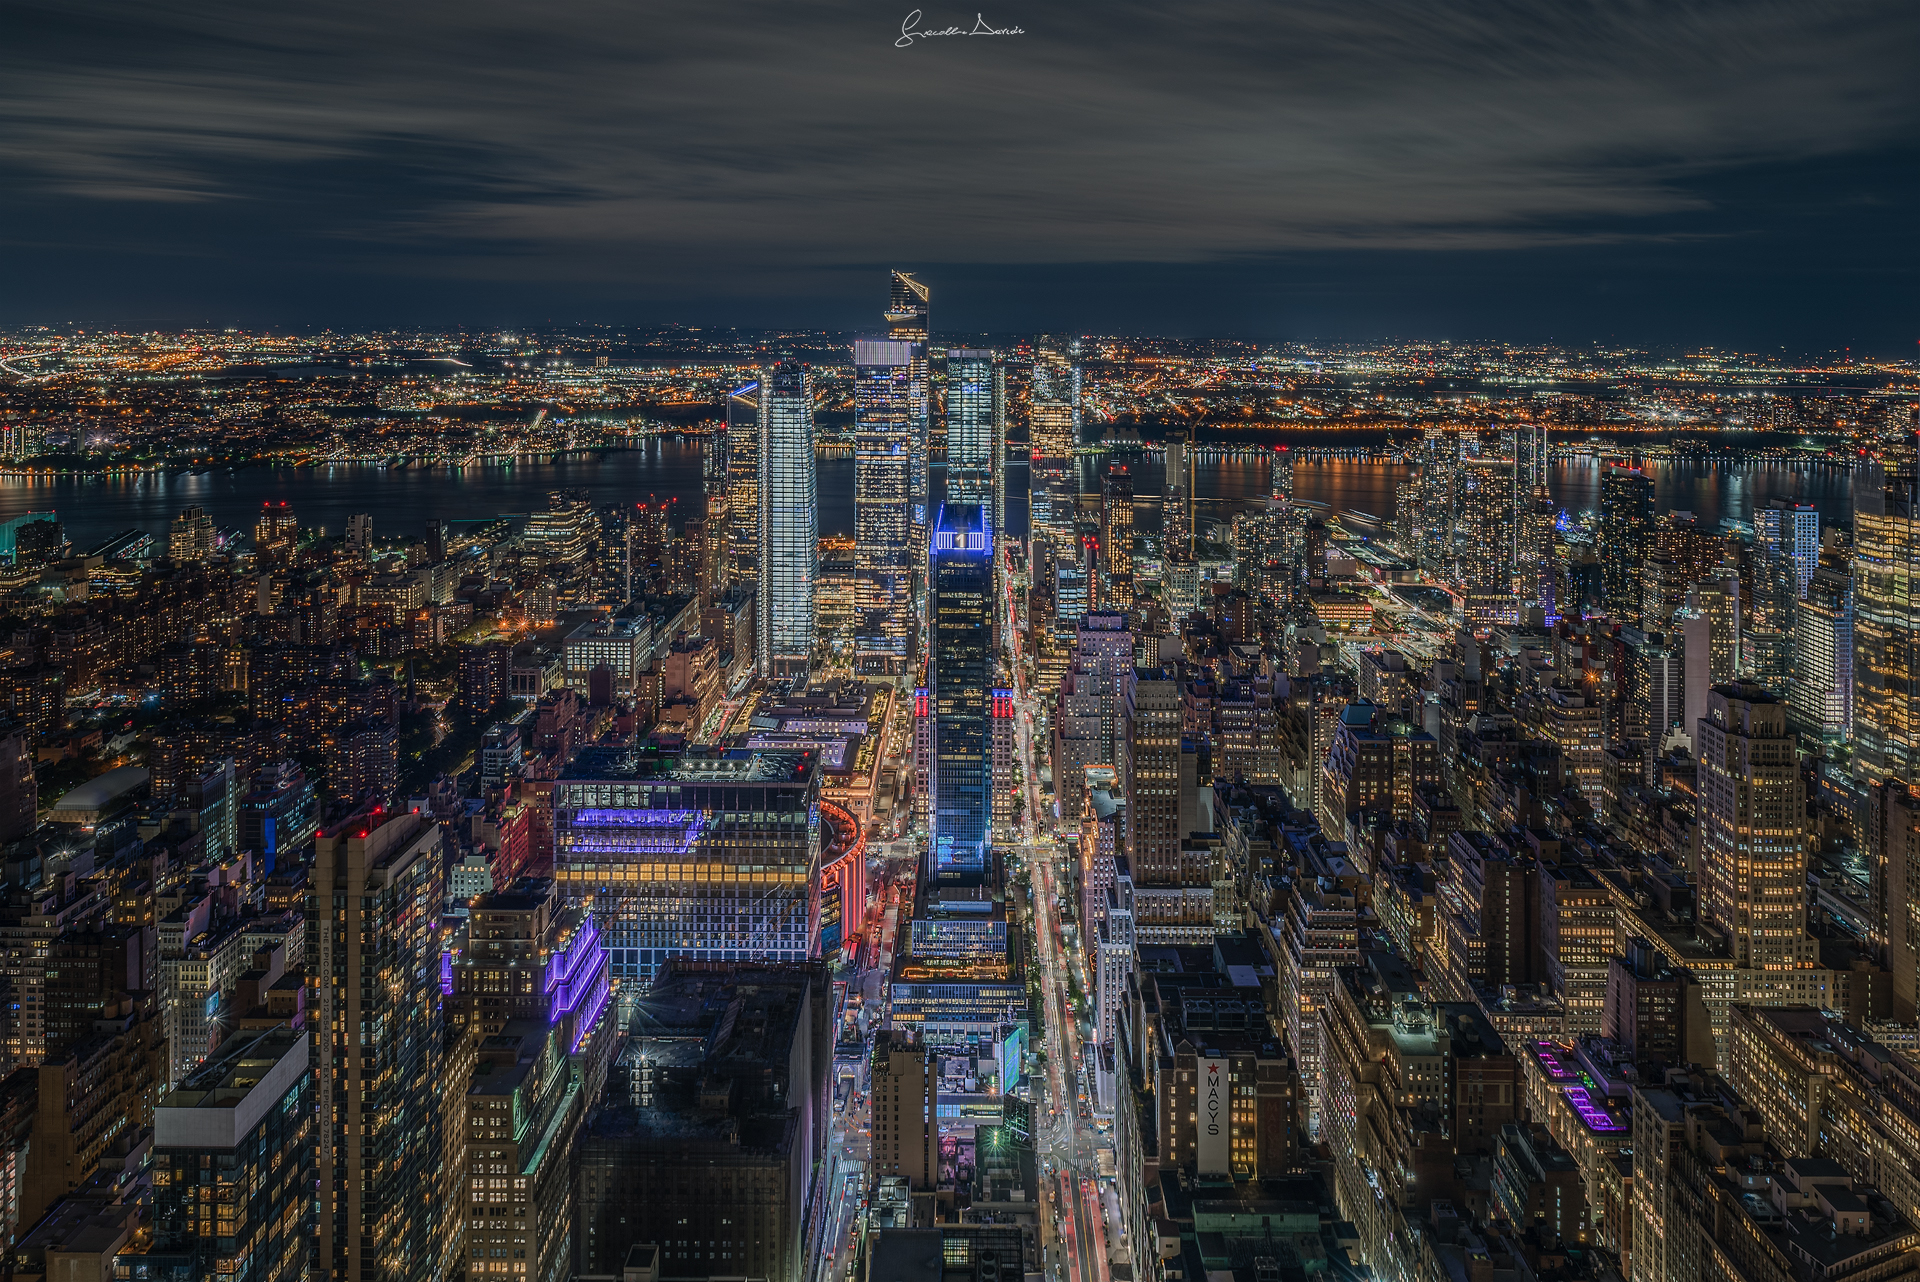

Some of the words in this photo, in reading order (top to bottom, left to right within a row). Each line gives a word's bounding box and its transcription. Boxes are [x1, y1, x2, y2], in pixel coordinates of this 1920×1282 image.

[956, 533, 965, 548] 1
[1207, 1075, 1219, 1136] MACYS
[323, 1114, 330, 1127] TO
